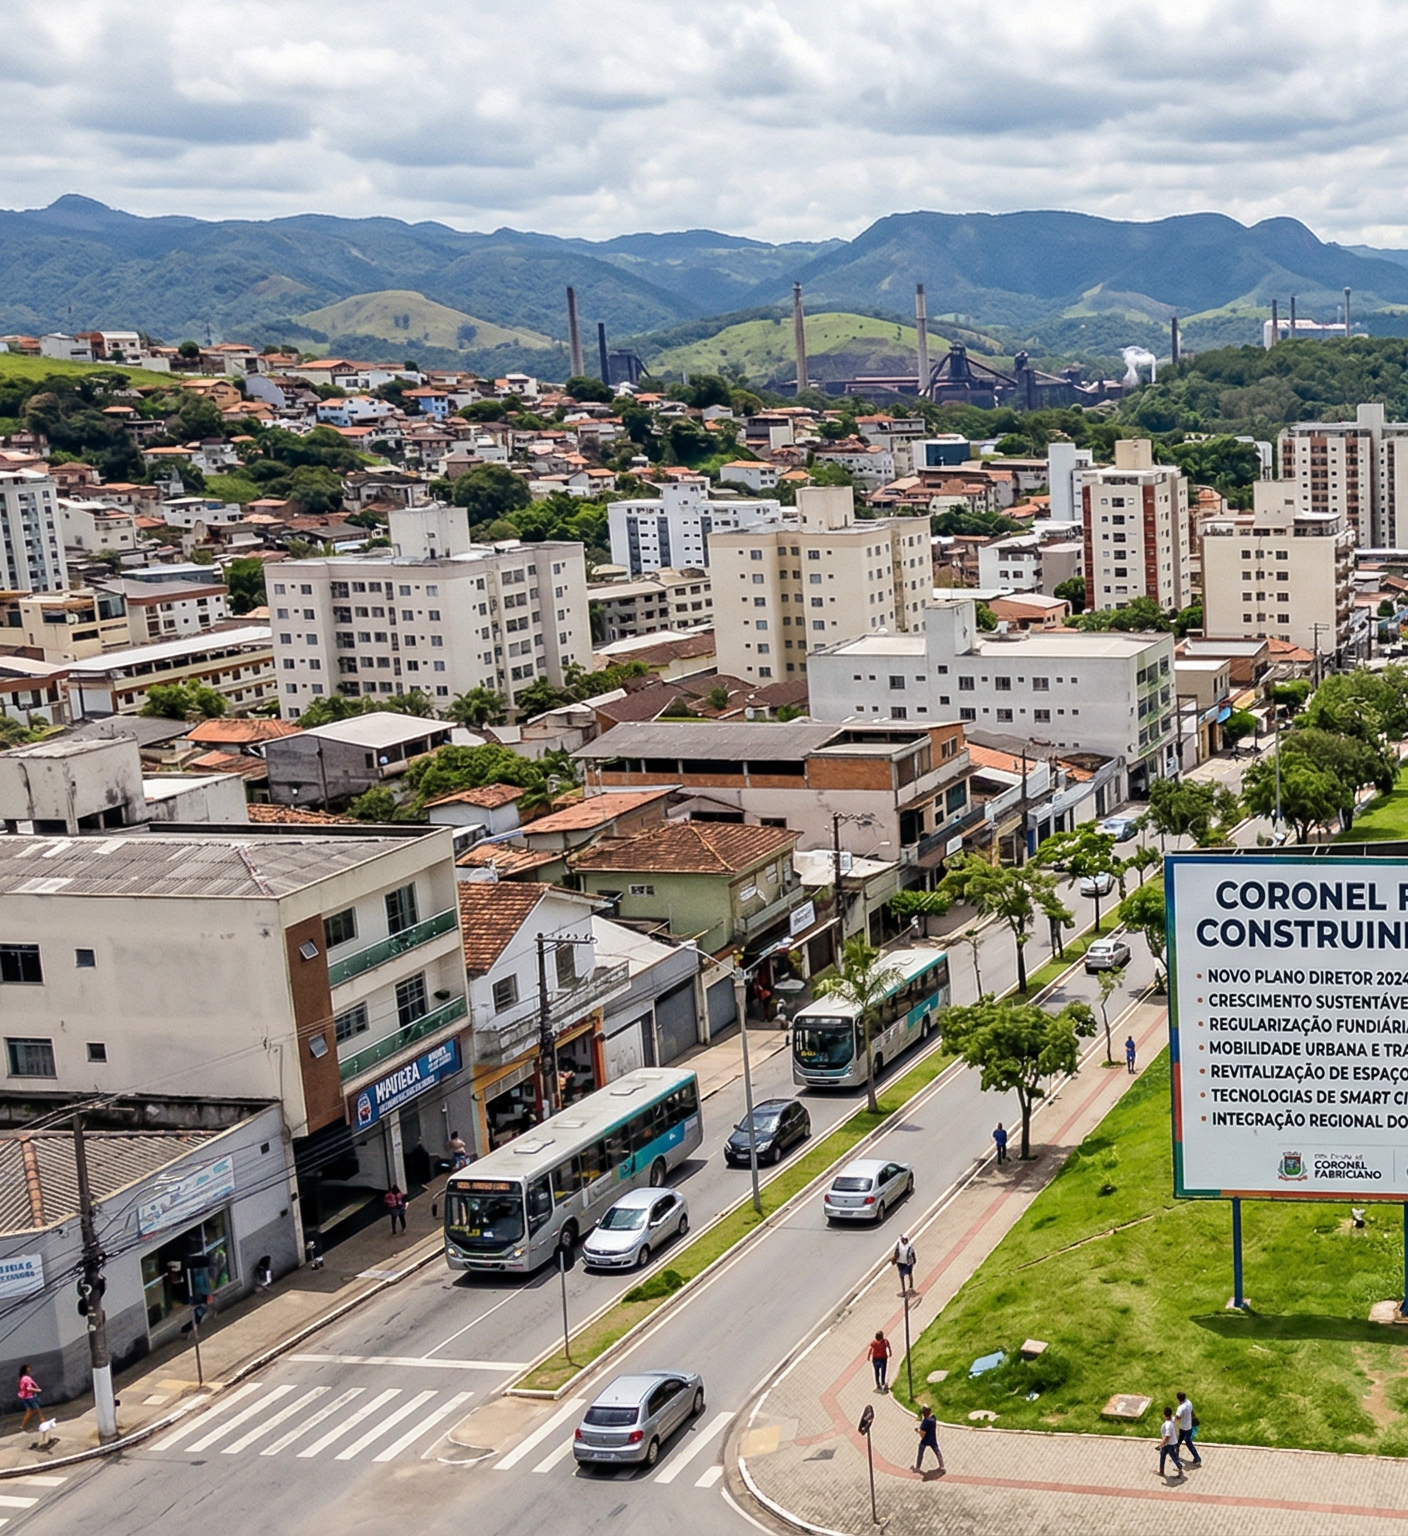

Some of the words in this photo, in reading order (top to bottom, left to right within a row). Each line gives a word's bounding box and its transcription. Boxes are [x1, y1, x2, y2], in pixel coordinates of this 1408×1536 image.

[1216, 881, 1386, 911] CORONEL
[1208, 969, 1250, 984] NOVO
[1255, 970, 1305, 984] PLANO
[1309, 971, 1373, 985] DIRETOR
[1209, 993, 1312, 1009] CRESCIMENTO
[1210, 1015, 1332, 1036] REGULARIZAÇÃO
[1210, 1041, 1301, 1056] MOBILIDADE
[1305, 1042, 1368, 1056] URBANA
[1371, 1043, 1380, 1057] E
[1211, 1062, 1325, 1083] REVITALIZAÇÃO
[1329, 1066, 1349, 1080] DE
[1211, 1088, 1312, 1104] TECNOLOGIAS
[1316, 1089, 1336, 1104] DE
[1340, 1090, 1391, 1105] SMART
[1212, 1109, 1305, 1130] INTEGRAÇÃO
[1310, 1113, 1383, 1129] REGIONAL
[1388, 1114, 1408, 1129] DO
